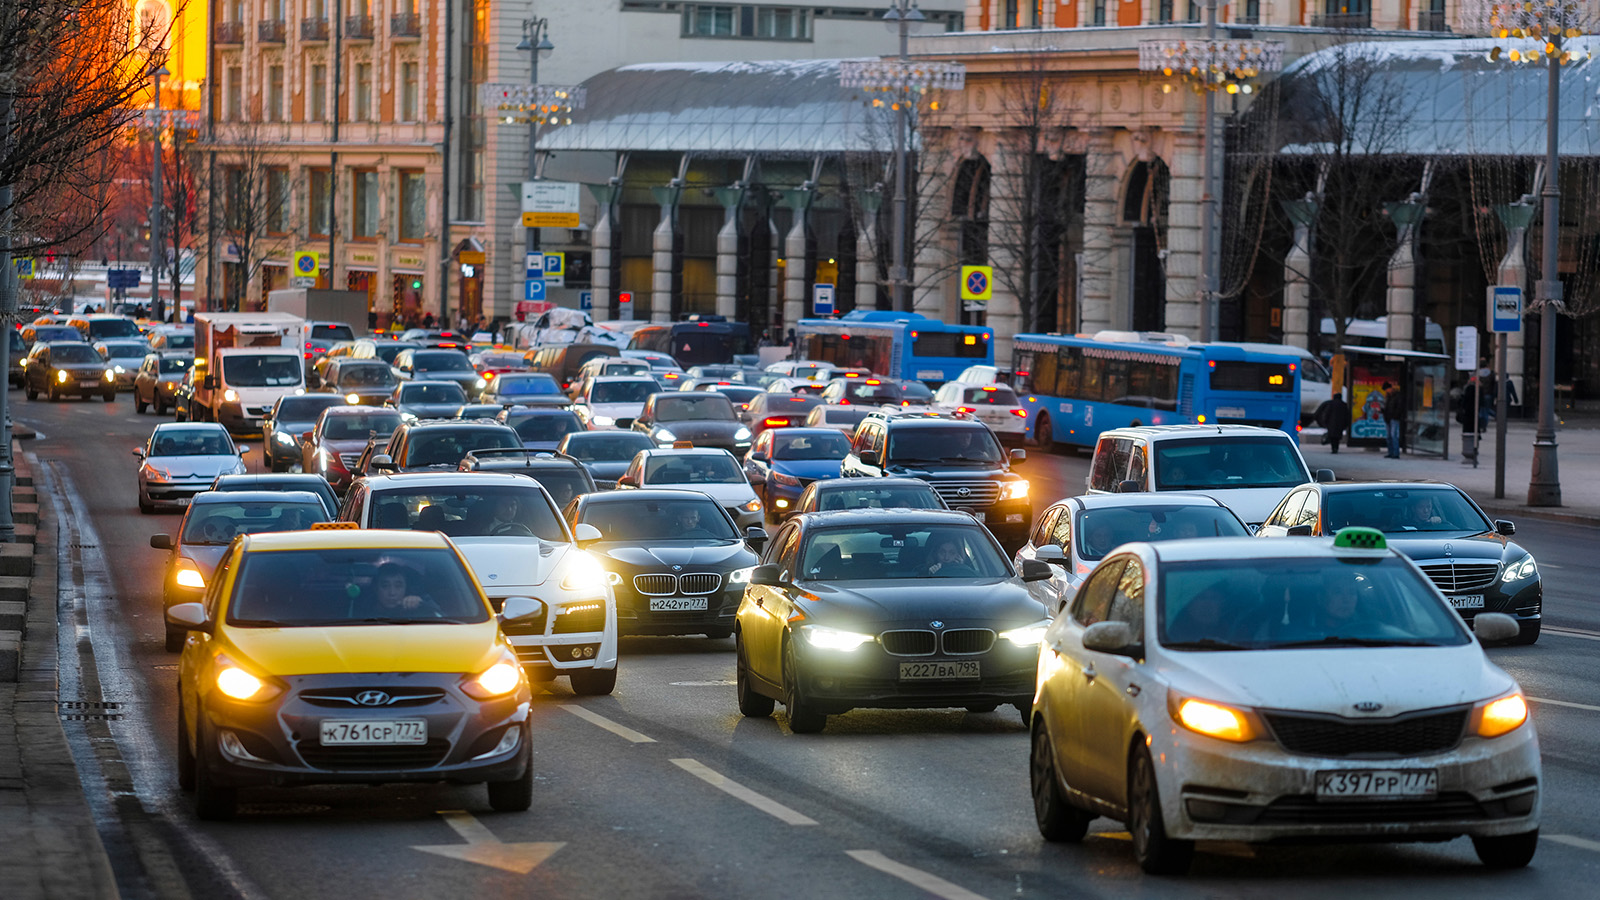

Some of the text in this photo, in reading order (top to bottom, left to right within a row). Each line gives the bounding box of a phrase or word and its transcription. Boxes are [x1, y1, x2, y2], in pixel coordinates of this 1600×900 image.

[530, 281, 542, 298] P
[691, 598, 706, 606] 777
[957, 662, 977, 673] 799
[395, 723, 420, 735] 777
[1402, 772, 1432, 786] 777
